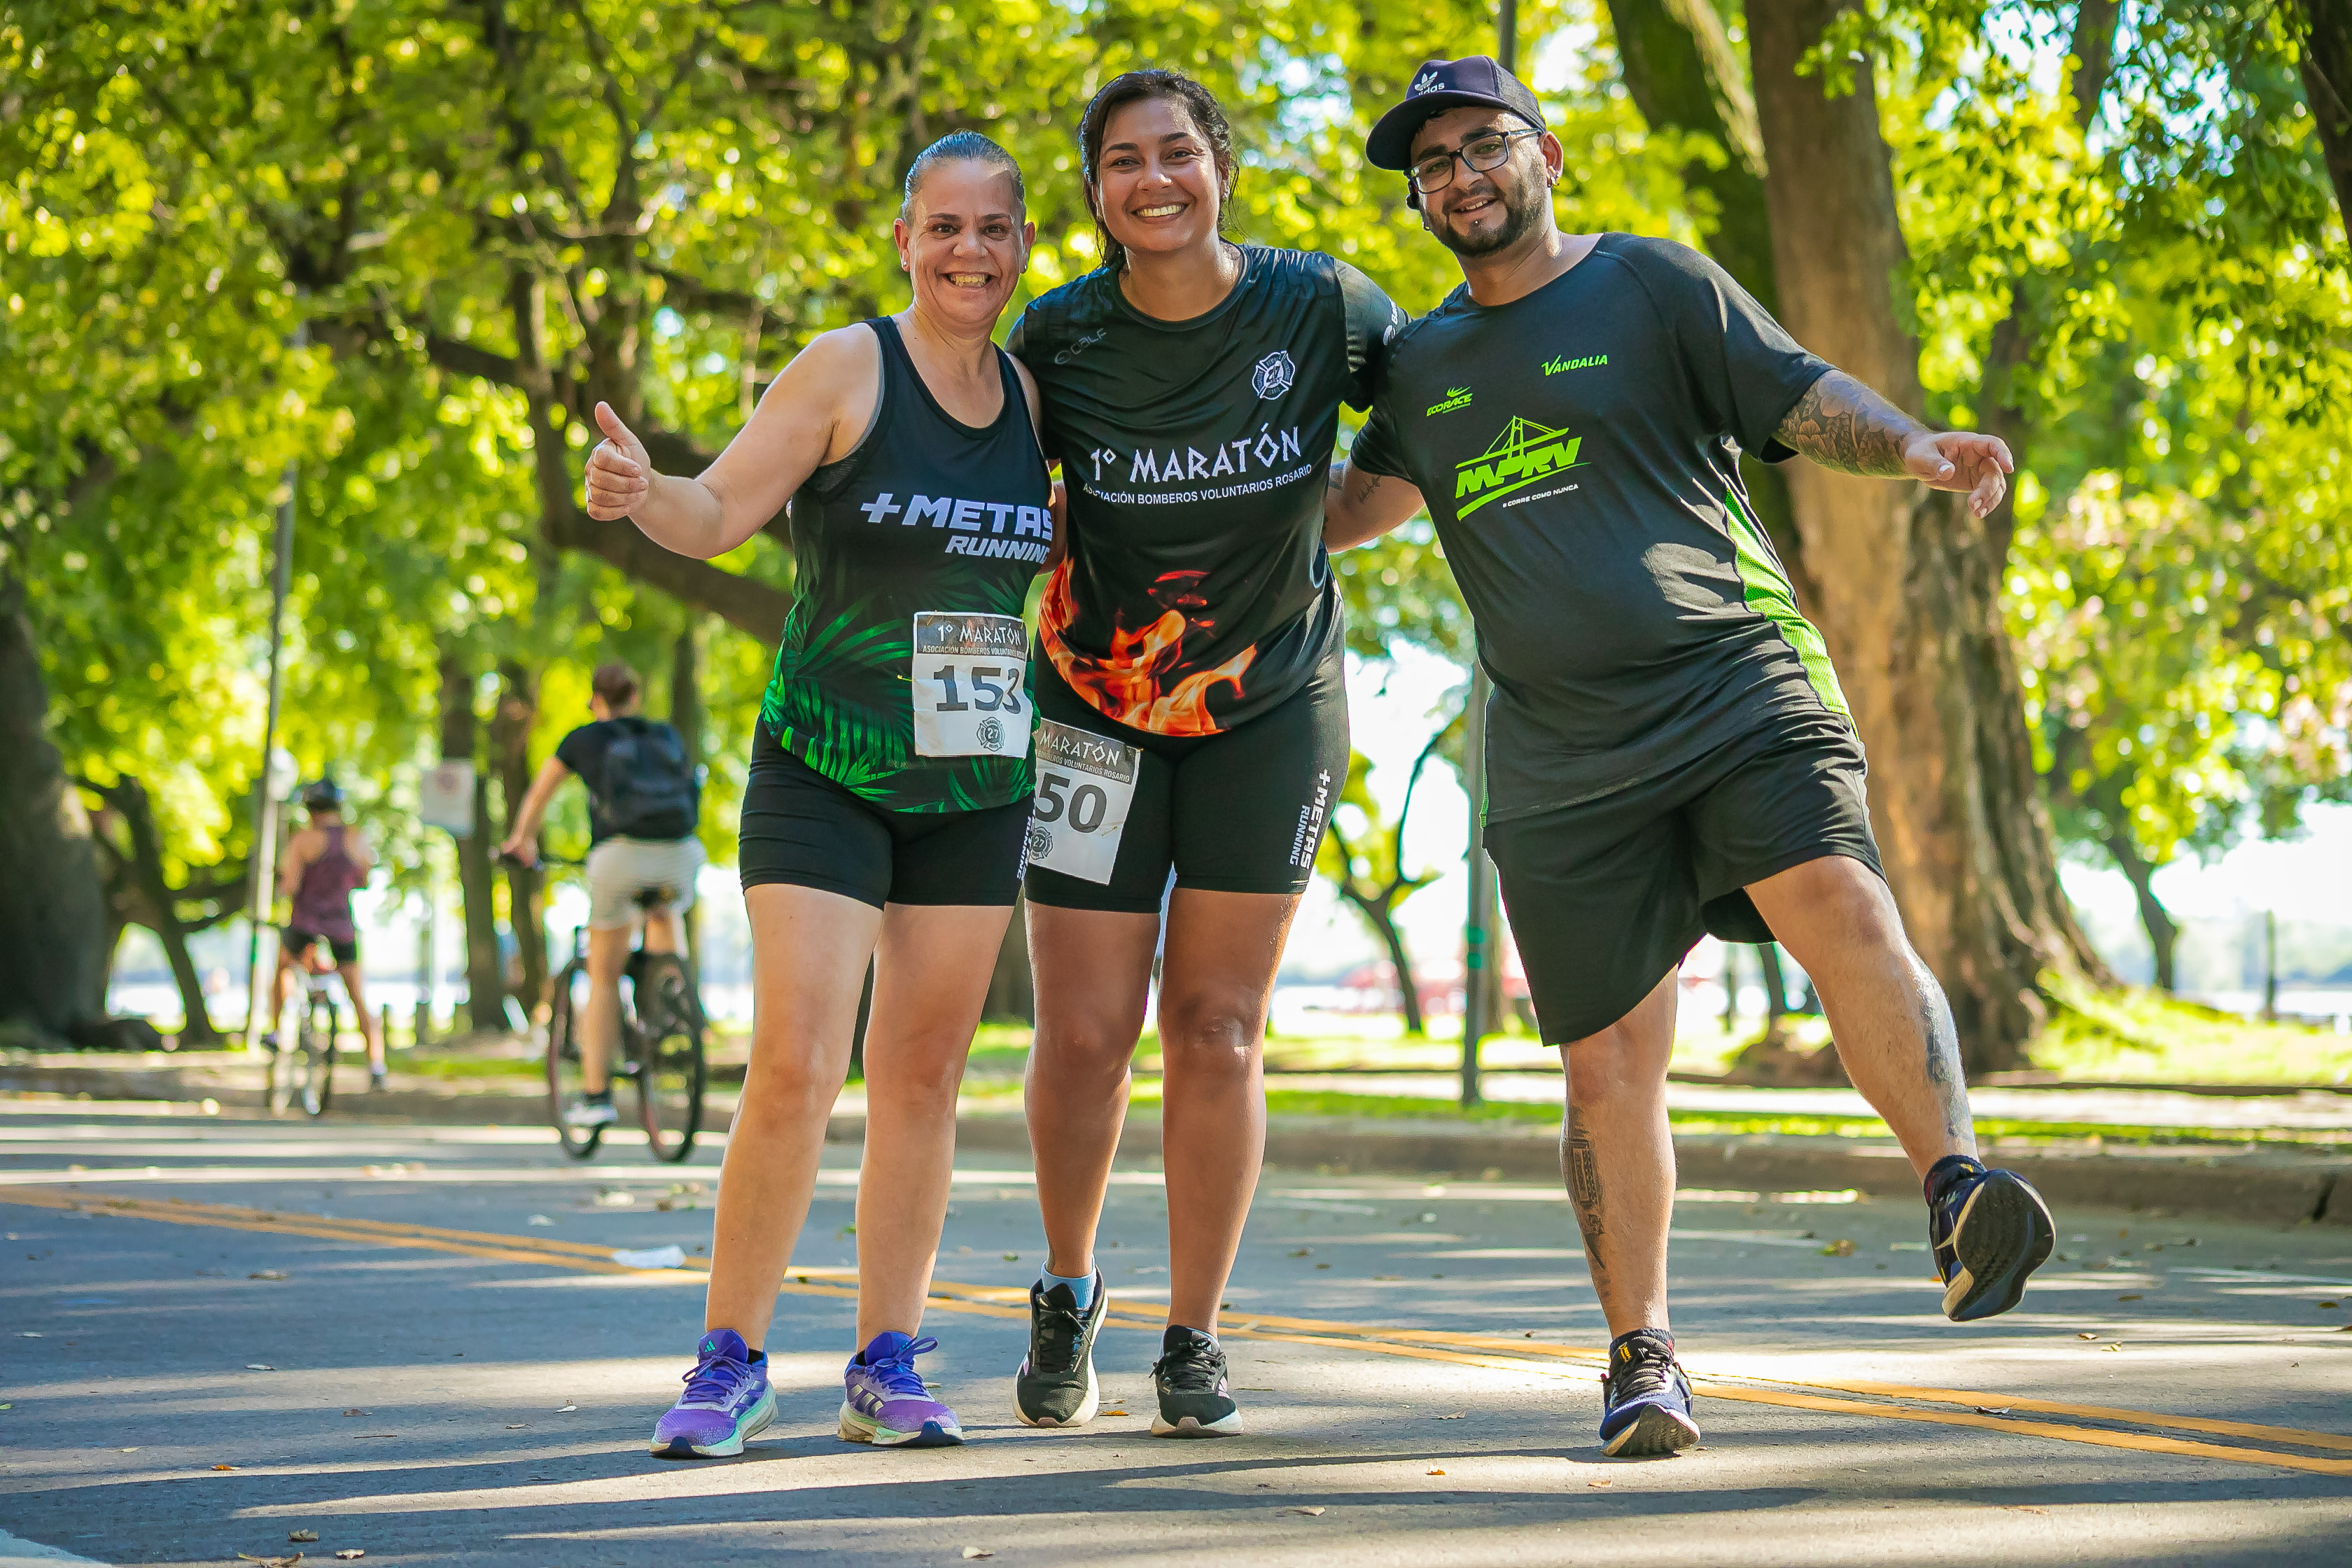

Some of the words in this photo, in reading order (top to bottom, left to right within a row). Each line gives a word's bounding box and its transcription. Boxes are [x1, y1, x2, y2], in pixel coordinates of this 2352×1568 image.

[1541, 354, 1608, 376] VANDALIA
[1426, 393, 1474, 417] ECORACE
[1129, 421, 1302, 484] MARATÓN
[1138, 491, 1198, 505] BOMBEROS
[1200, 479, 1274, 500] VOLUNTARIOS
[1275, 463, 1312, 488] ROSARIO
[1531, 491, 1552, 500] COMO
[1553, 483, 1579, 496] NUNCA
[958, 622, 1022, 647] MARATÓN
[922, 645, 959, 654] ASOCIACIÓN
[960, 646, 991, 656] BOMBEROS
[933, 664, 1022, 715] 153
[987, 727, 1000, 740] 27
[1039, 730, 1121, 768] MARATÓN
[1063, 757, 1104, 776] VOLUNTARIOS
[1103, 767, 1130, 783] ROSARIO
[1300, 768, 1331, 870] +METAS
[1289, 804, 1311, 866] RUNNING
